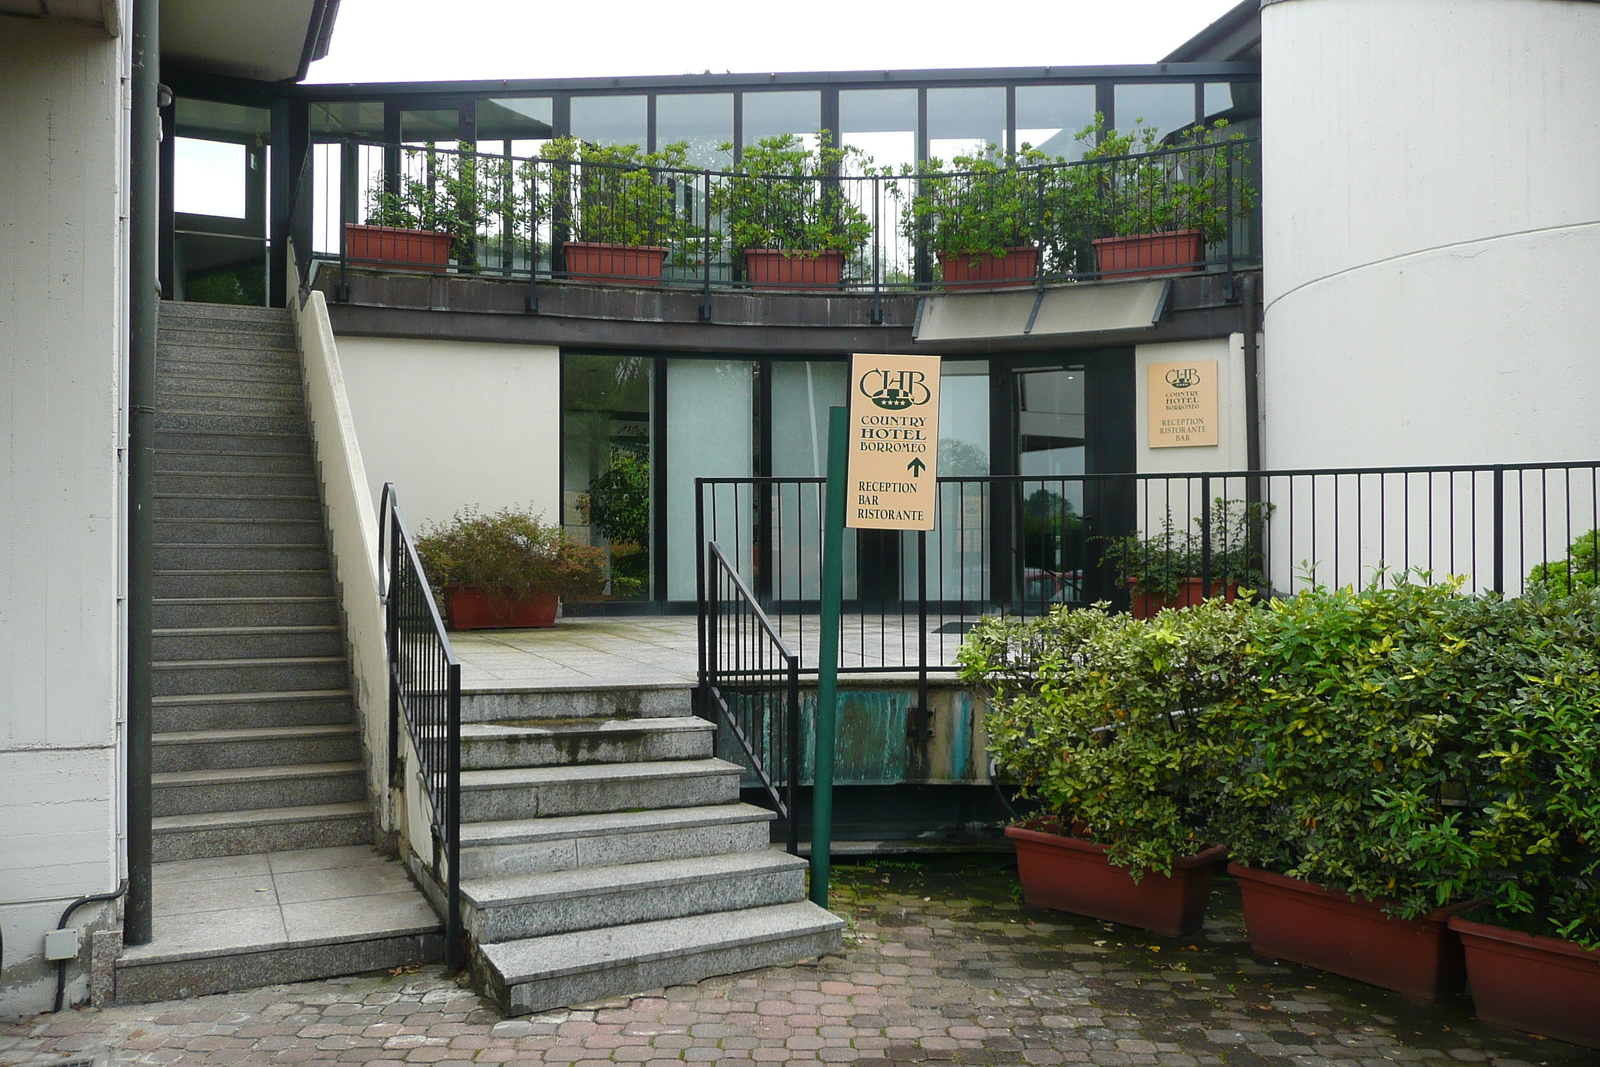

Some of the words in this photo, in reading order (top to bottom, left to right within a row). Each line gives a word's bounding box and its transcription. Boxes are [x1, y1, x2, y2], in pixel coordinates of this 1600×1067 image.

[861, 415, 927, 427] COUNTRY
[1162, 418, 1204, 426] RECEPTION
[861, 428, 927, 441] HOTEL
[1160, 426, 1206, 434] RISTORANTE
[860, 441, 927, 453] BORROMEO
[858, 481, 918, 493] RECEPTION
[858, 495, 879, 505] BAR
[857, 508, 924, 521] RISTORANTE
